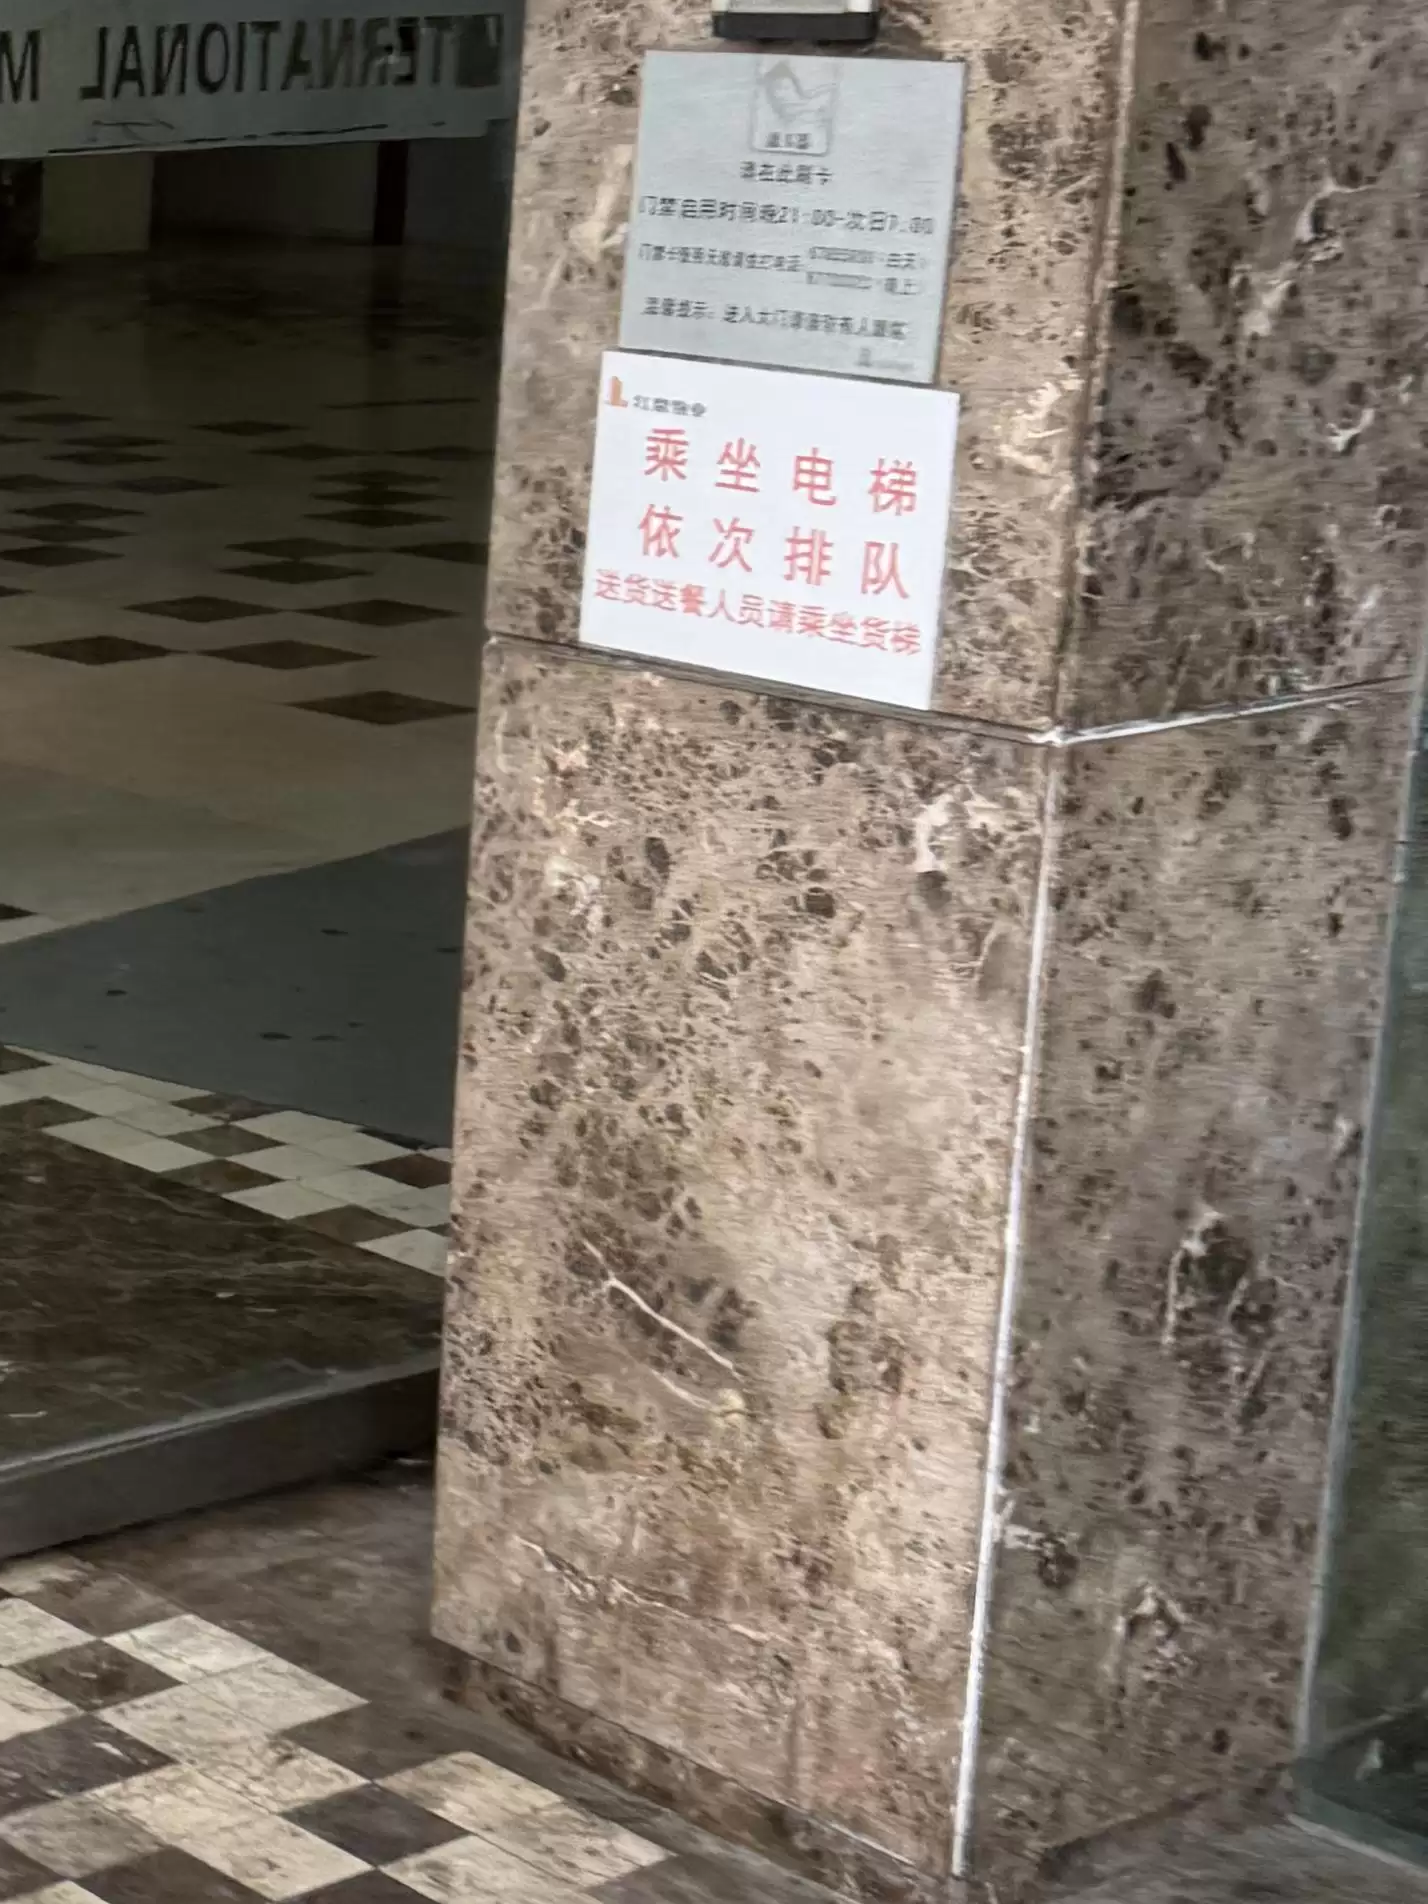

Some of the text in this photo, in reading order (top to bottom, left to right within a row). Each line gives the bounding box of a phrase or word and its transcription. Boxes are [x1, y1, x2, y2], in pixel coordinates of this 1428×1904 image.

[644, 428, 918, 516] 乘坐电梯
[638, 503, 910, 599] 依次排队
[595, 567, 921, 657] 送货送餐人员请乘坐货梯
